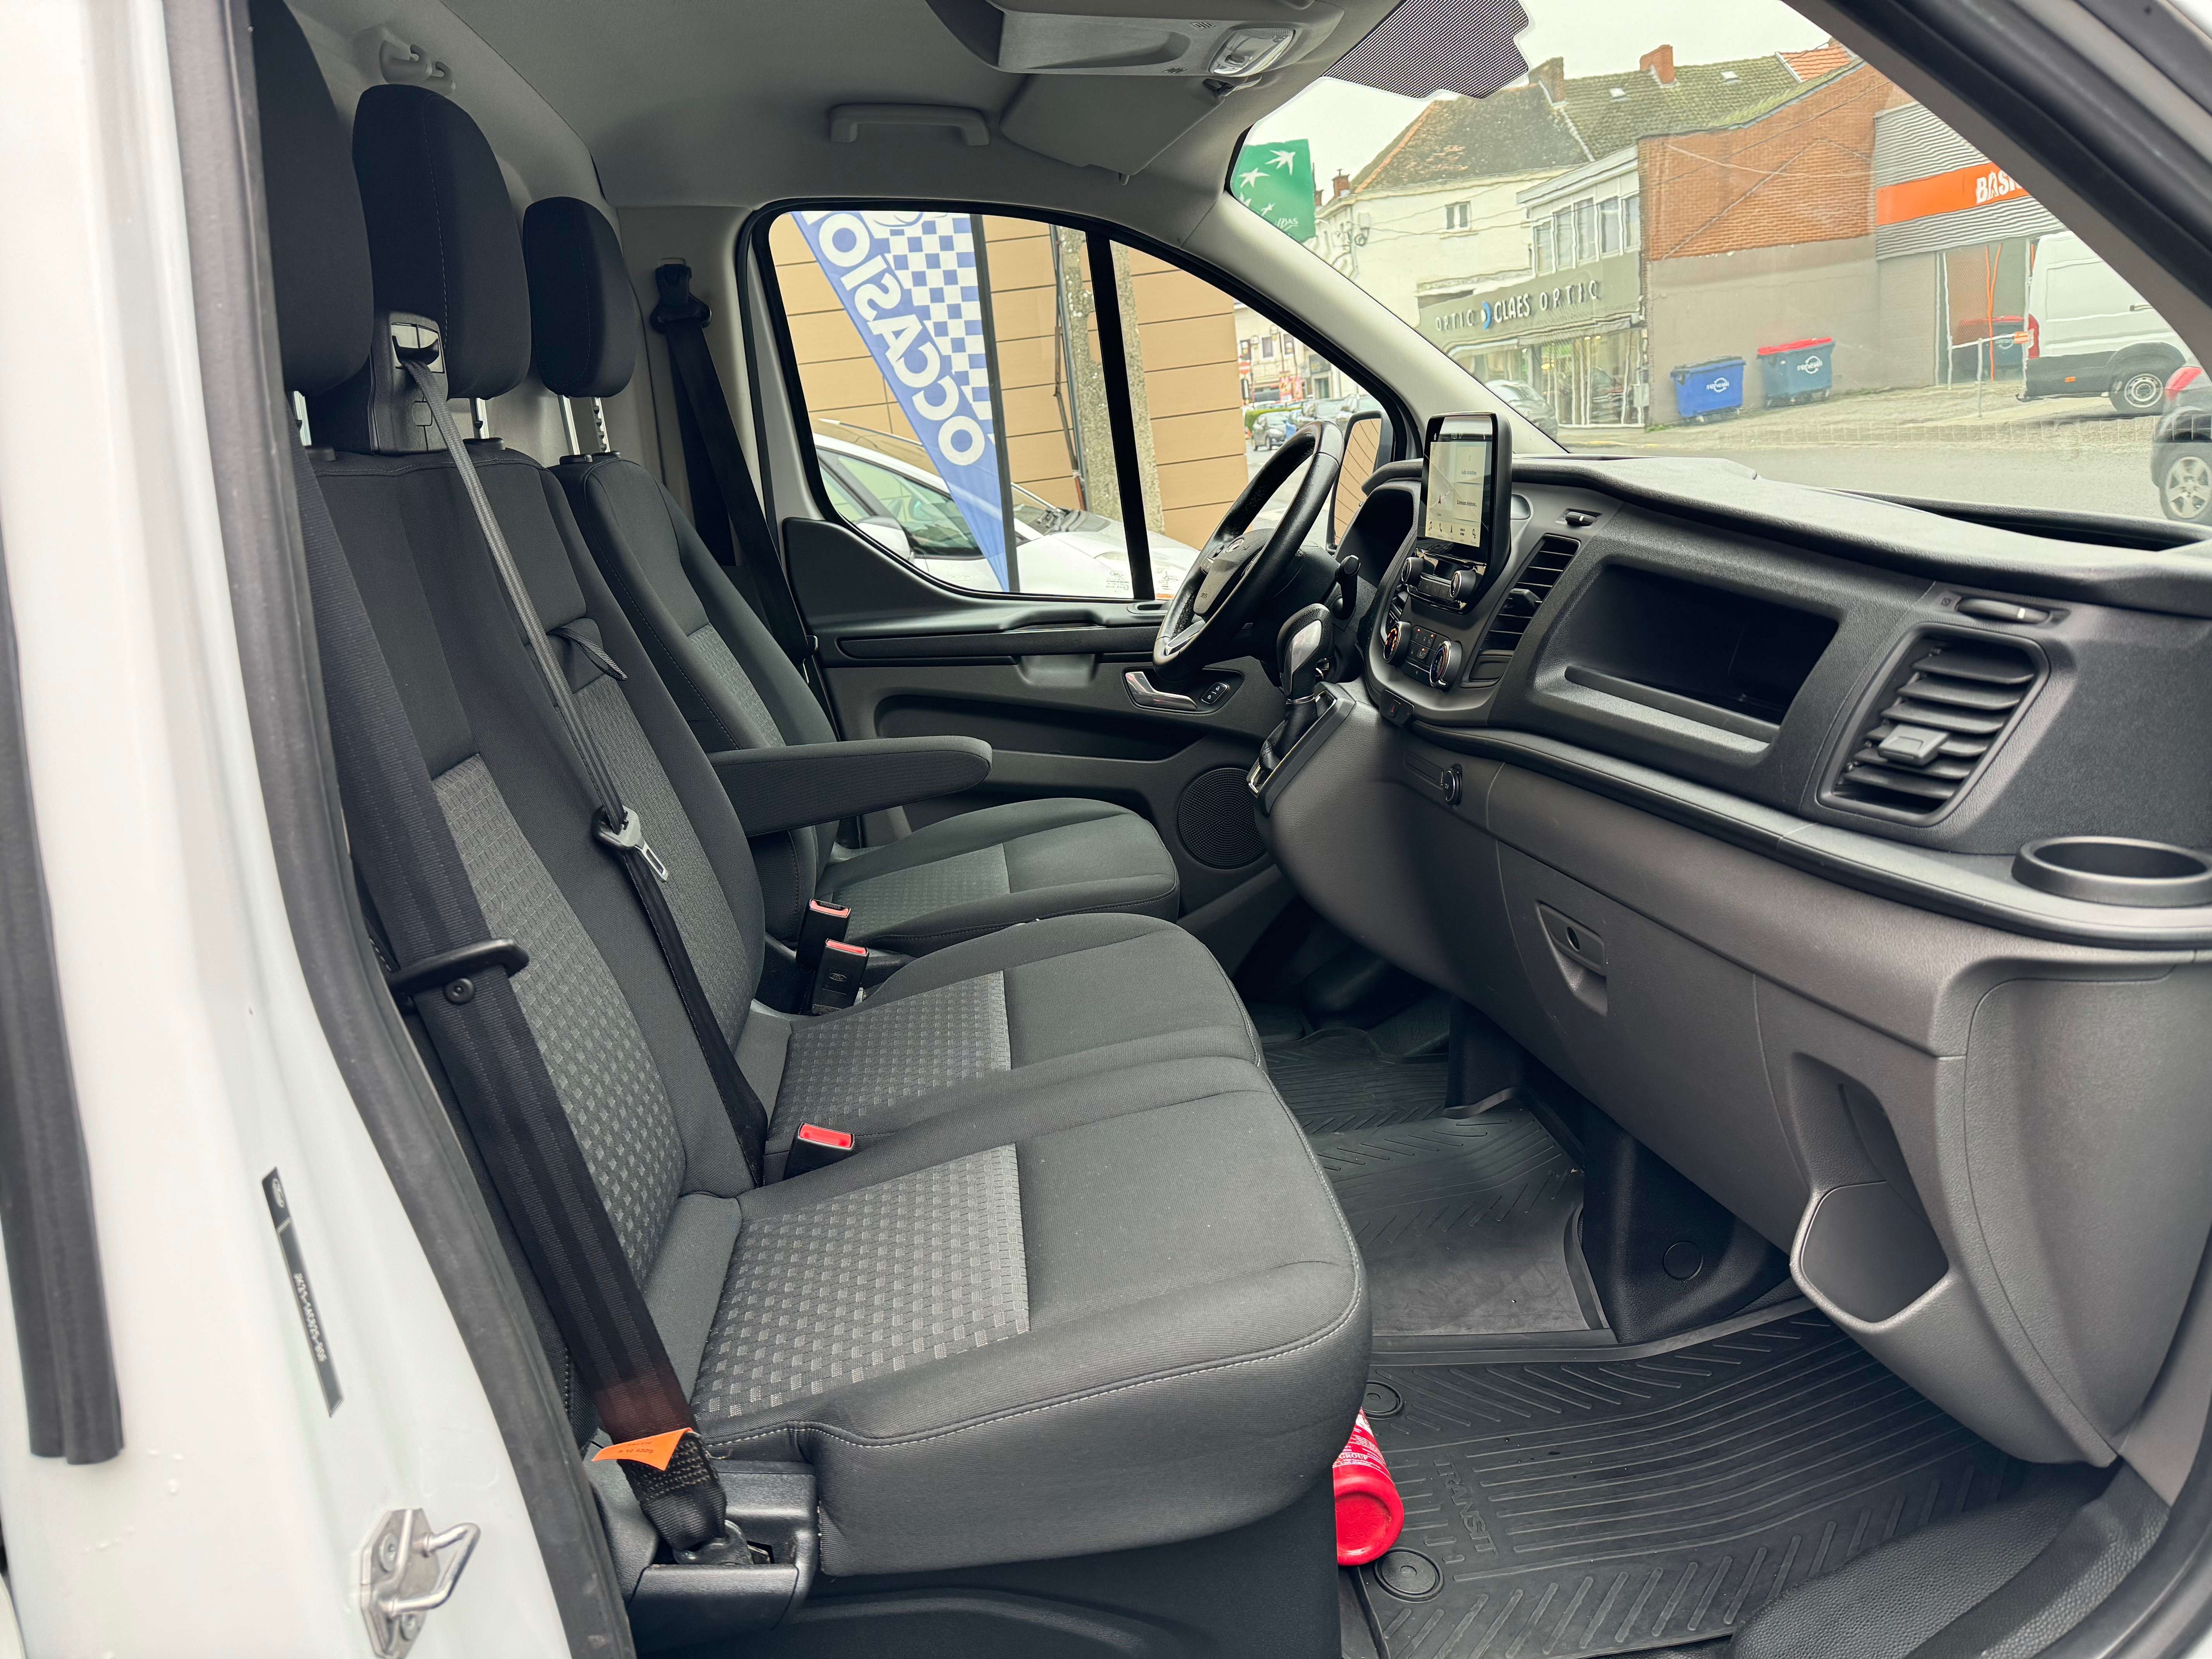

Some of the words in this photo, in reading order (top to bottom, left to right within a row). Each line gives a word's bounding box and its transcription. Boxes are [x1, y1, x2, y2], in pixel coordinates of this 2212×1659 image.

[1976, 169, 2023, 204] BASI
[1436, 309, 1472, 331] OPTIC
[1494, 293, 1530, 323] CLAES
[1539, 280, 1598, 310] OPTIC
[1433, 1454, 1498, 1555] TRANSIT
